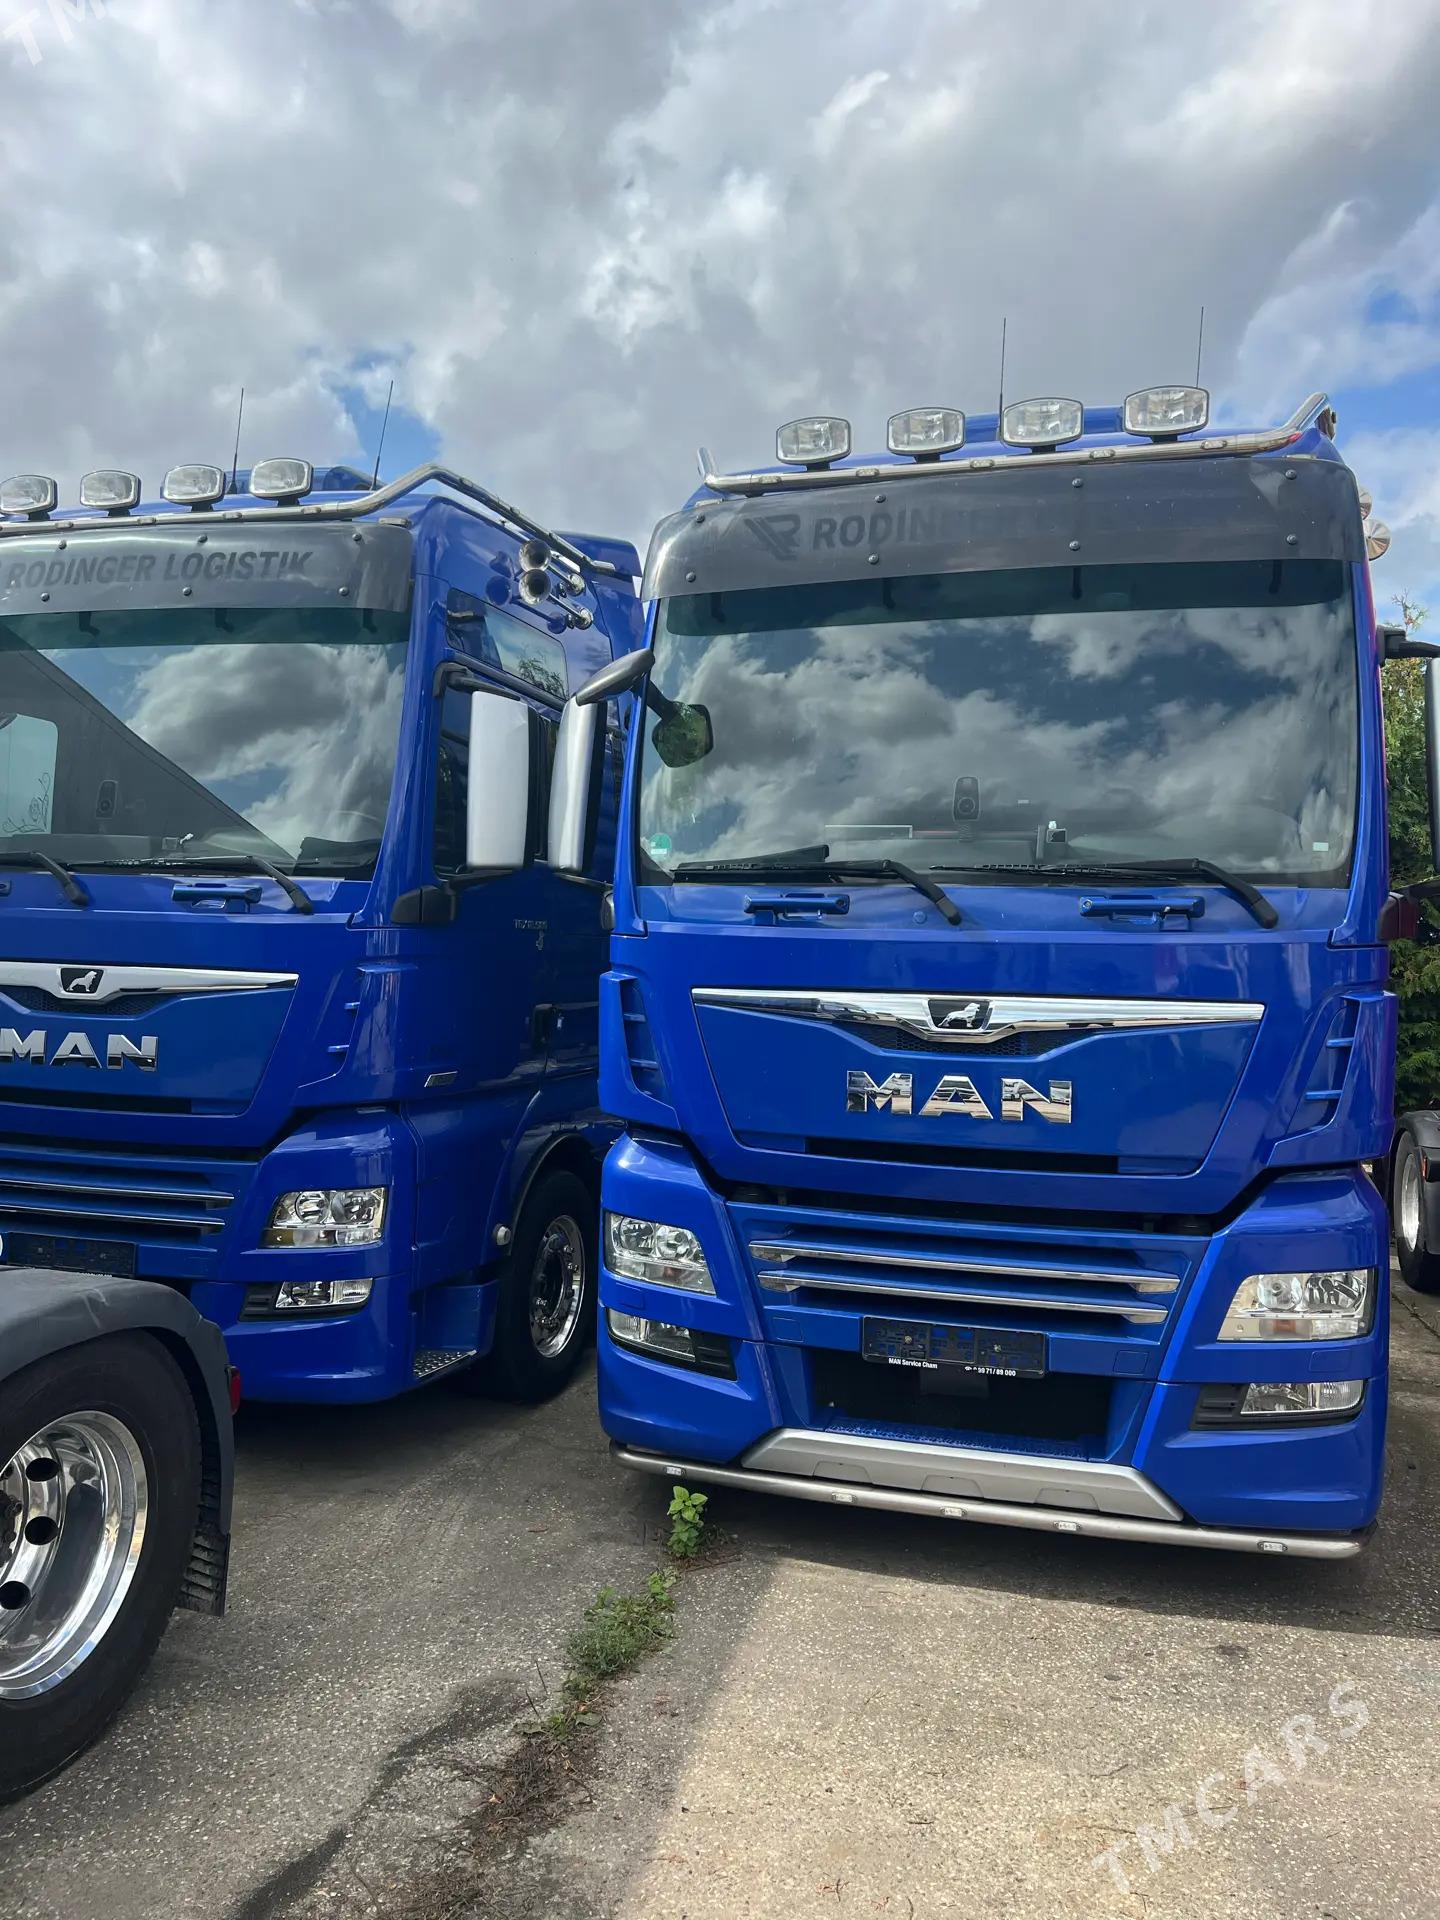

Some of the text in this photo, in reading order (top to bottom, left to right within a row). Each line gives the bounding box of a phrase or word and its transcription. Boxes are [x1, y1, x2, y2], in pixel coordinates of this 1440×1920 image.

[8, 551, 314, 588] RODINGER LOGISTIK
[0, 1027, 159, 1073] MAN
[846, 1070, 1072, 1123] MAN
[888, 1357, 901, 1365] MAN
[902, 1359, 921, 1367] Service
[922, 1361, 938, 1369] Cham
